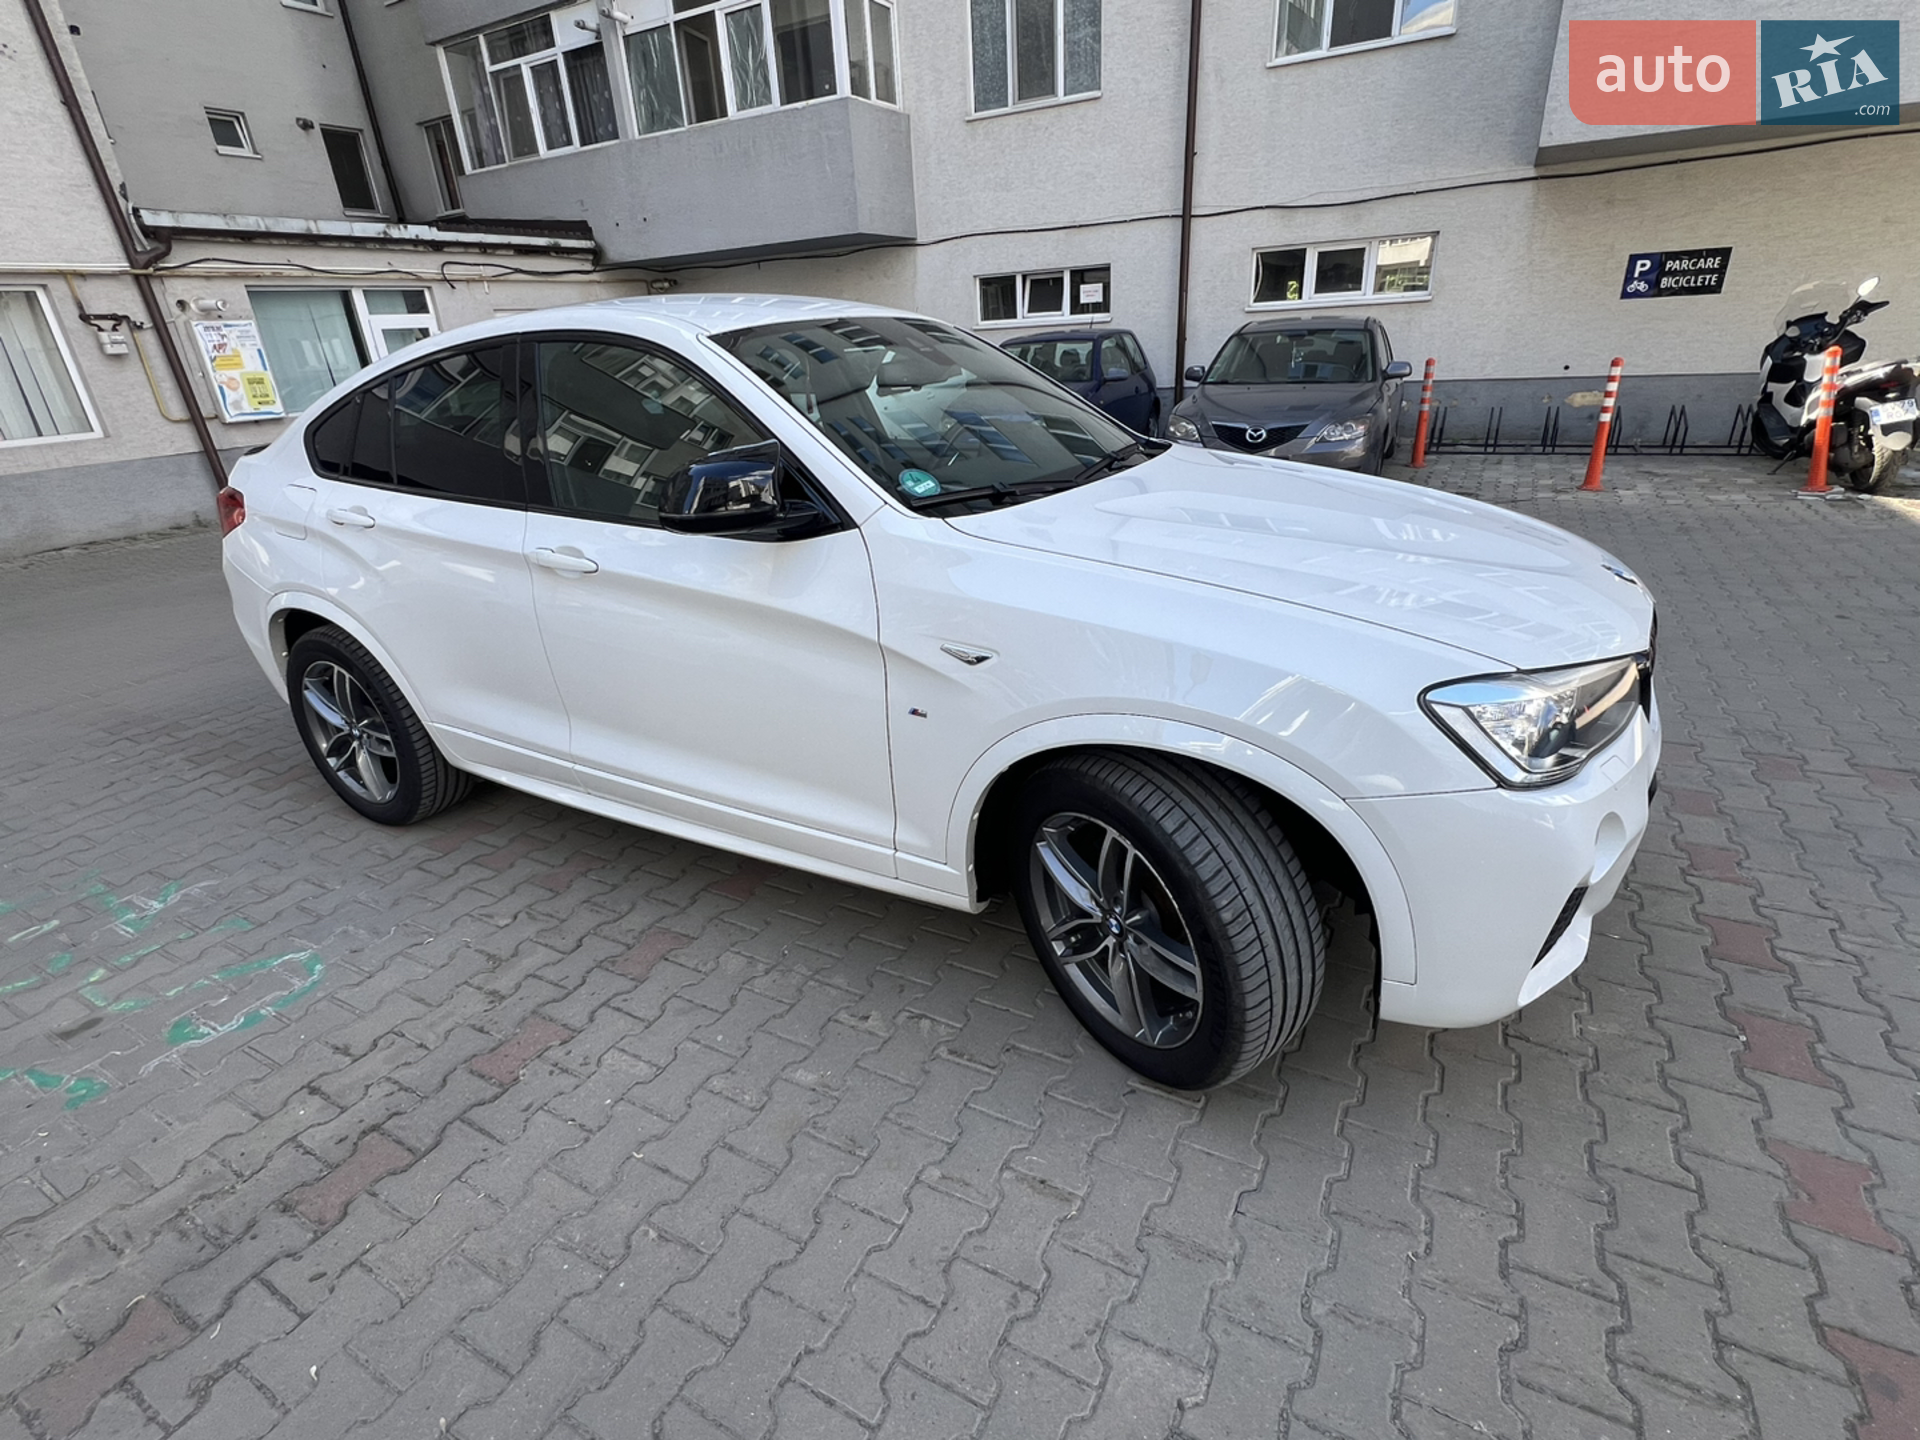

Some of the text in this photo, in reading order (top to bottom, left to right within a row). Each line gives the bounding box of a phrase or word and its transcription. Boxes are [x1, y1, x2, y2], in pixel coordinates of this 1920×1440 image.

[1633, 259, 1652, 278] P
[1665, 257, 1721, 271] PARCARE
[1660, 274, 1719, 288] BICICLETE
